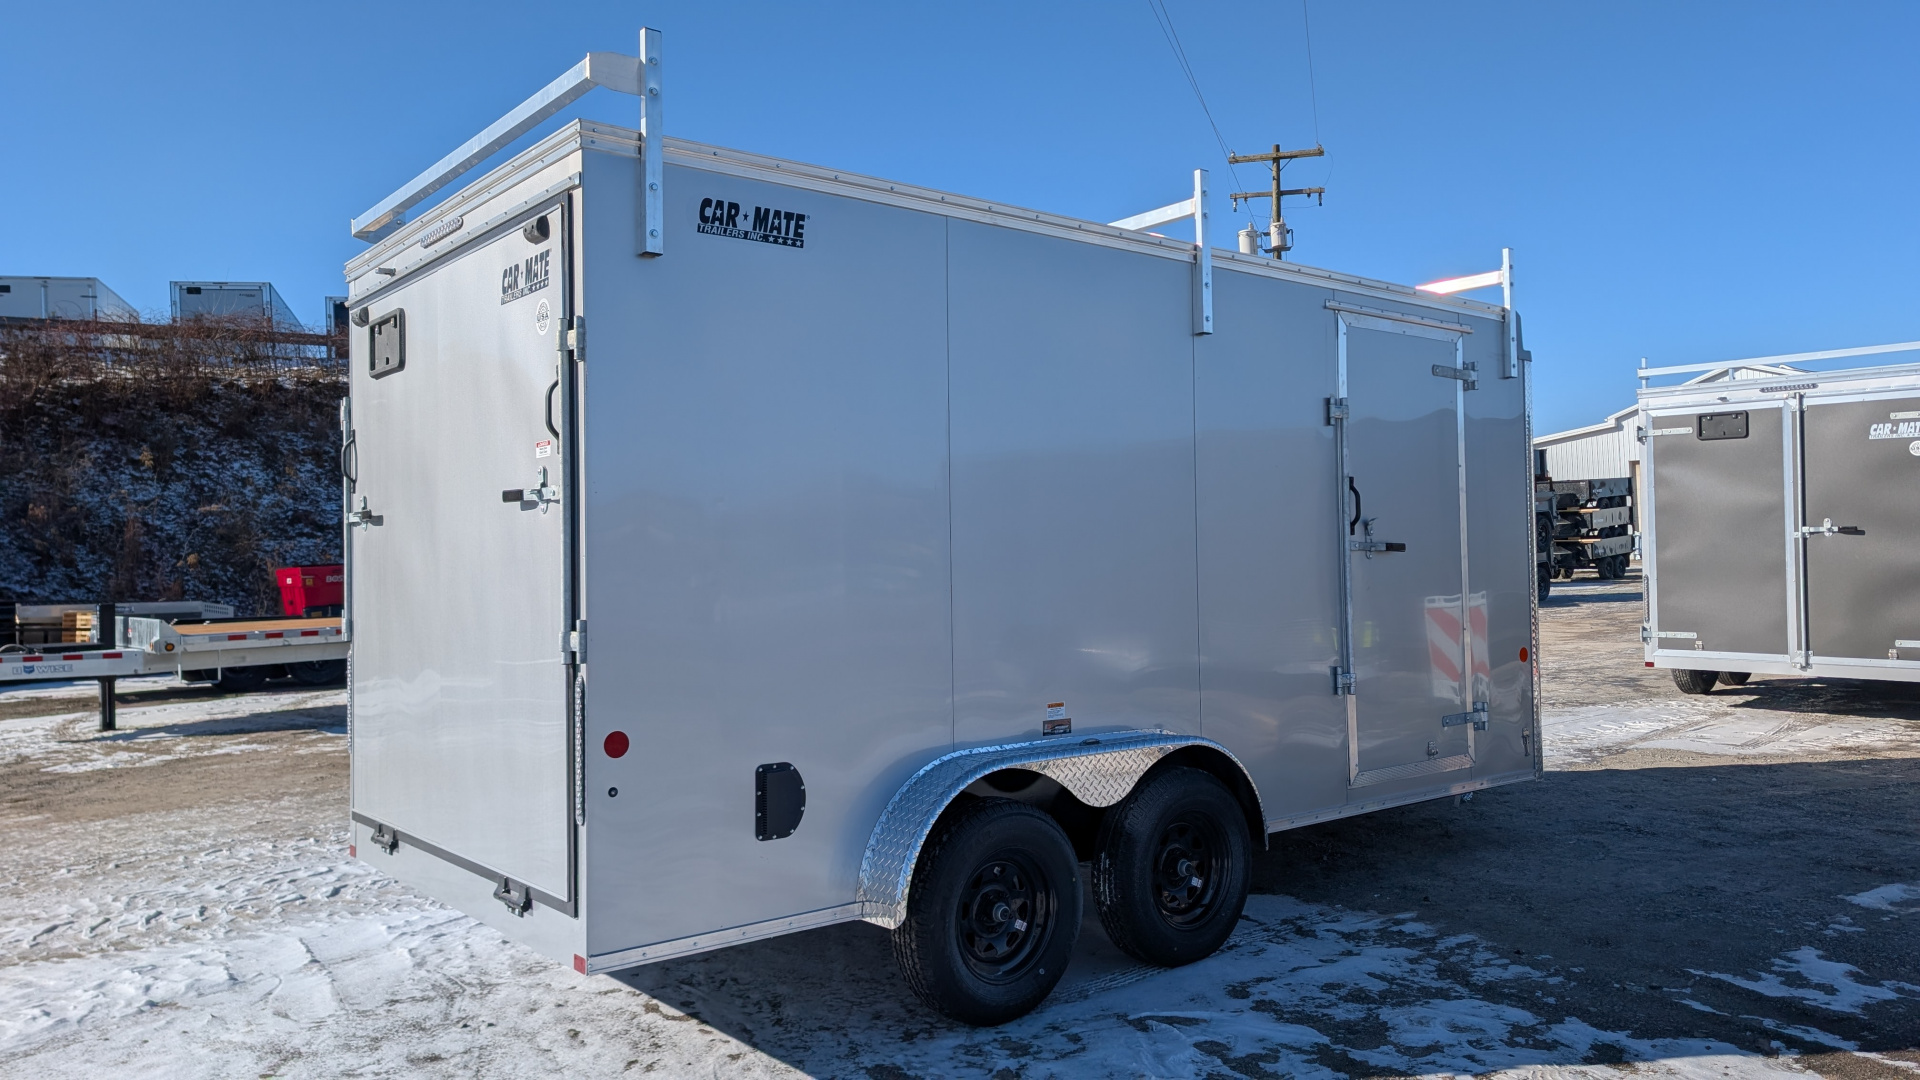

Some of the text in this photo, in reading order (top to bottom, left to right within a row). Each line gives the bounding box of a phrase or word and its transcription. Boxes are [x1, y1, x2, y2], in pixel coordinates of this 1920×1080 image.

[699, 197, 806, 238] CAR MATE
[699, 224, 766, 242] TRAILERS INC.
[502, 249, 550, 295] CAR MATE
[1870, 421, 1920, 436] CAR MAT
[326, 575, 344, 583] BOS
